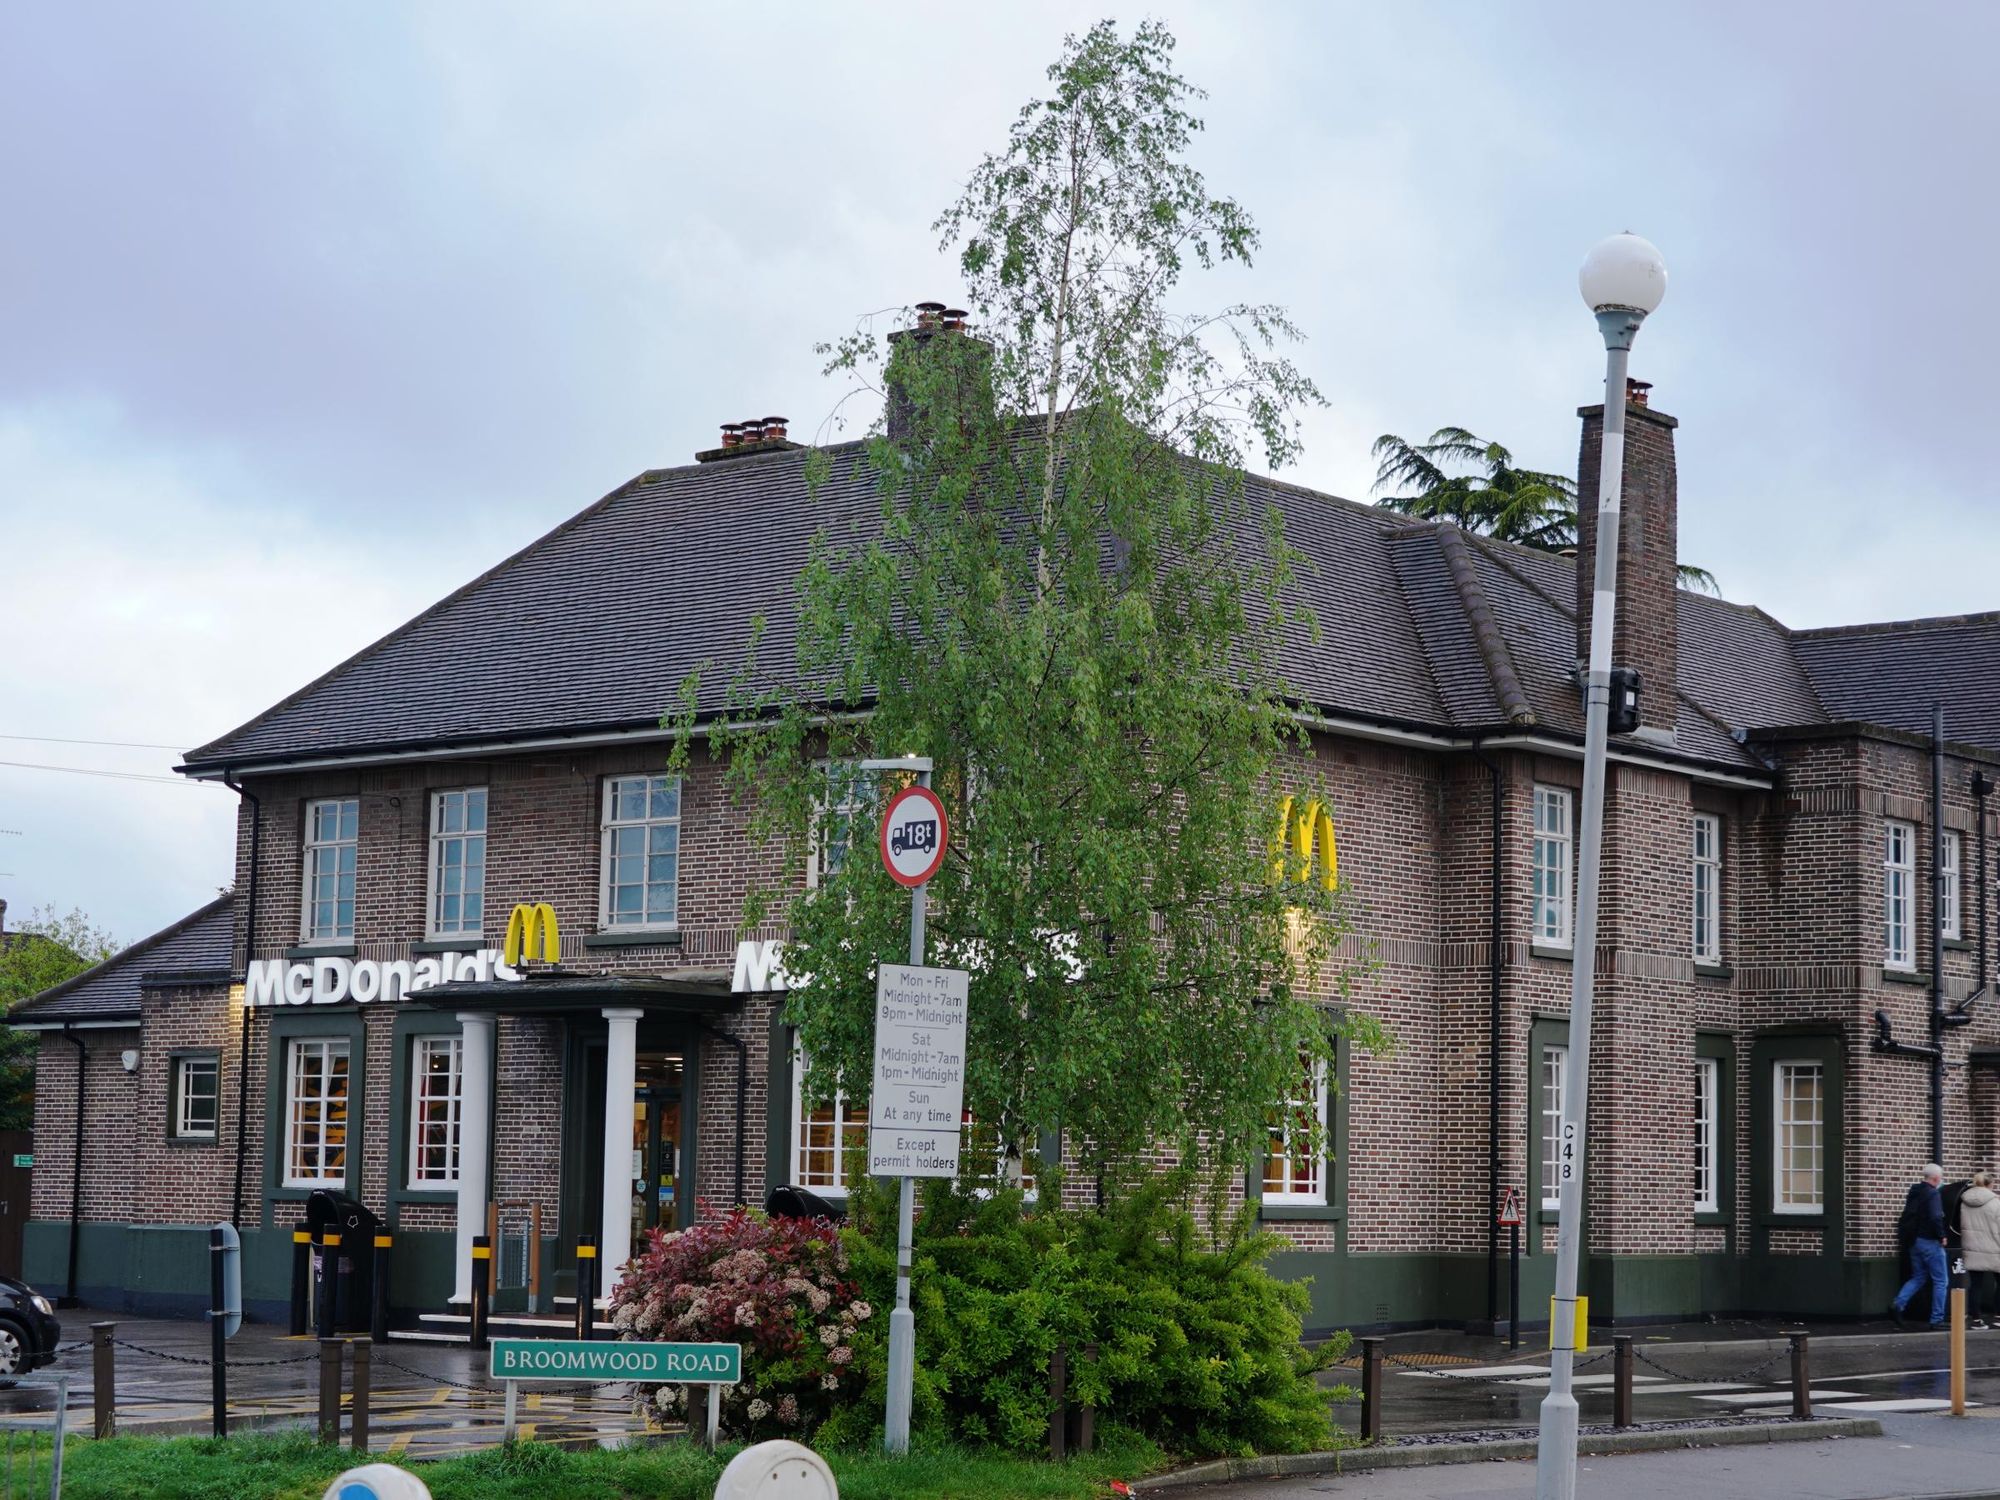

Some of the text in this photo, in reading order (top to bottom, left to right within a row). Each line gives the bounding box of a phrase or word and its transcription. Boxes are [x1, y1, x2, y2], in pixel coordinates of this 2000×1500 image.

[907, 823, 932, 846] 18t
[244, 949, 528, 1006] McDonald's
[900, 973, 923, 986] Mon
[934, 976, 949, 989] Fri
[912, 1032, 932, 1046] Sat
[909, 1091, 930, 1104] Sun
[883, 1107, 952, 1123] At any time
[897, 1137, 936, 1153] Except
[873, 1155, 955, 1169] permit holders
[503, 1350, 730, 1373] BROOMWOOD ROAD
